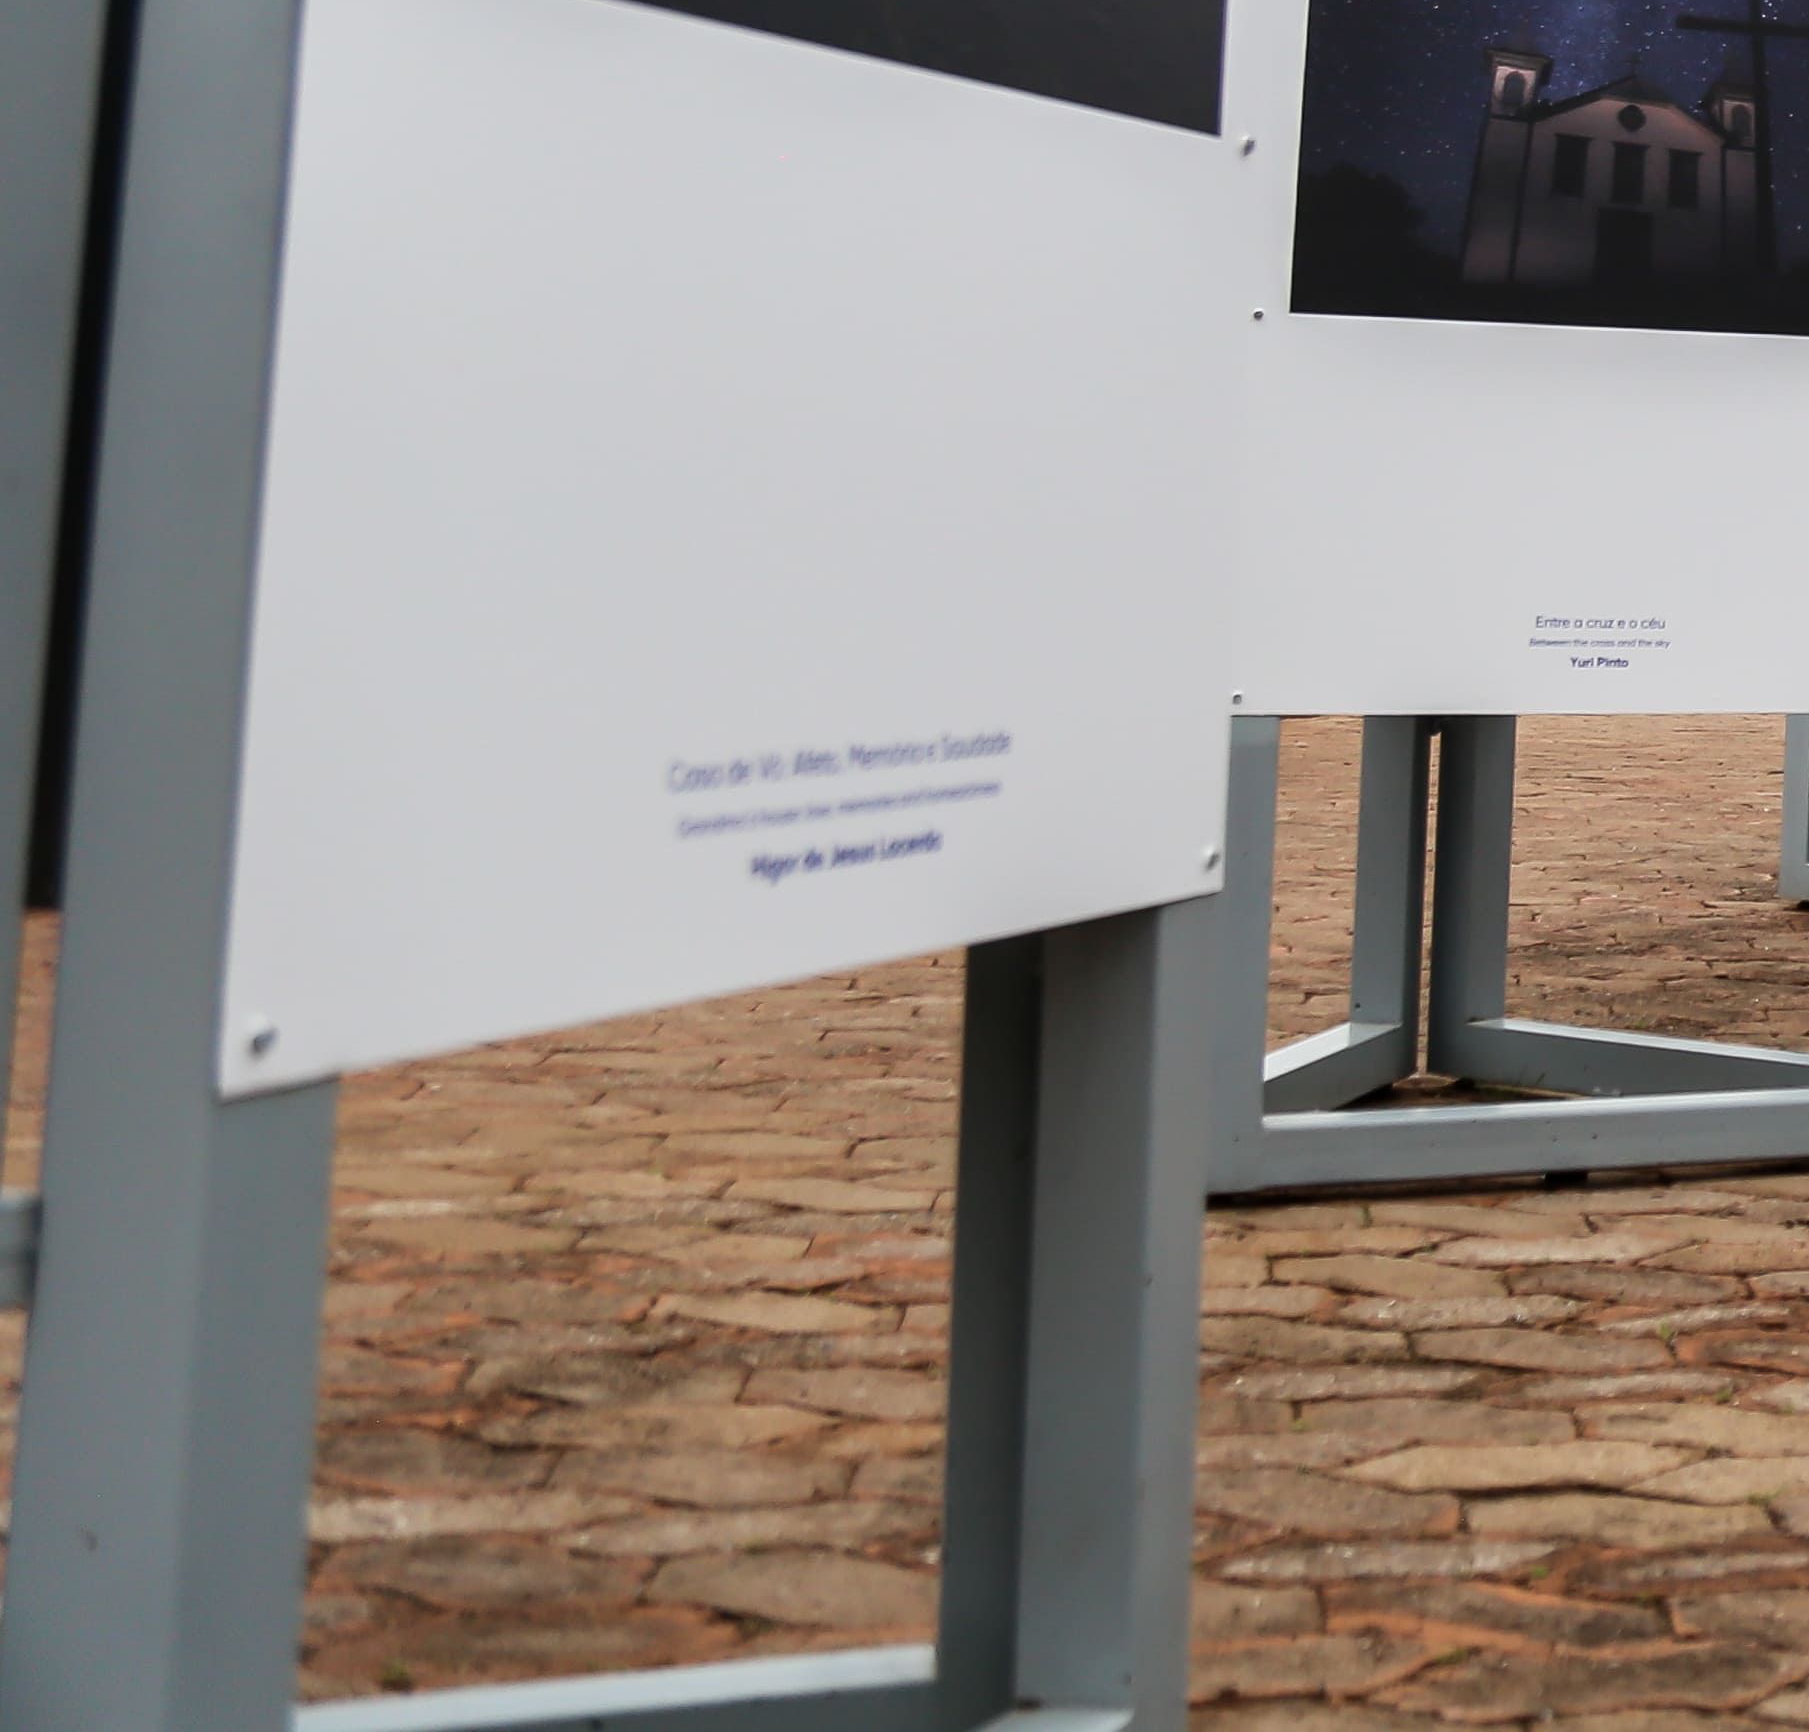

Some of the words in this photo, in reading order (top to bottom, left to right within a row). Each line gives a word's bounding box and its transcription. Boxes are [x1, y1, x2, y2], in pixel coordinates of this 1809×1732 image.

[1536, 616, 1570, 629] Entre
[1586, 618, 1614, 629] cruz
[1640, 616, 1666, 629] céu
[1570, 657, 1594, 668] Yuri
[1597, 657, 1629, 668] Pinto
